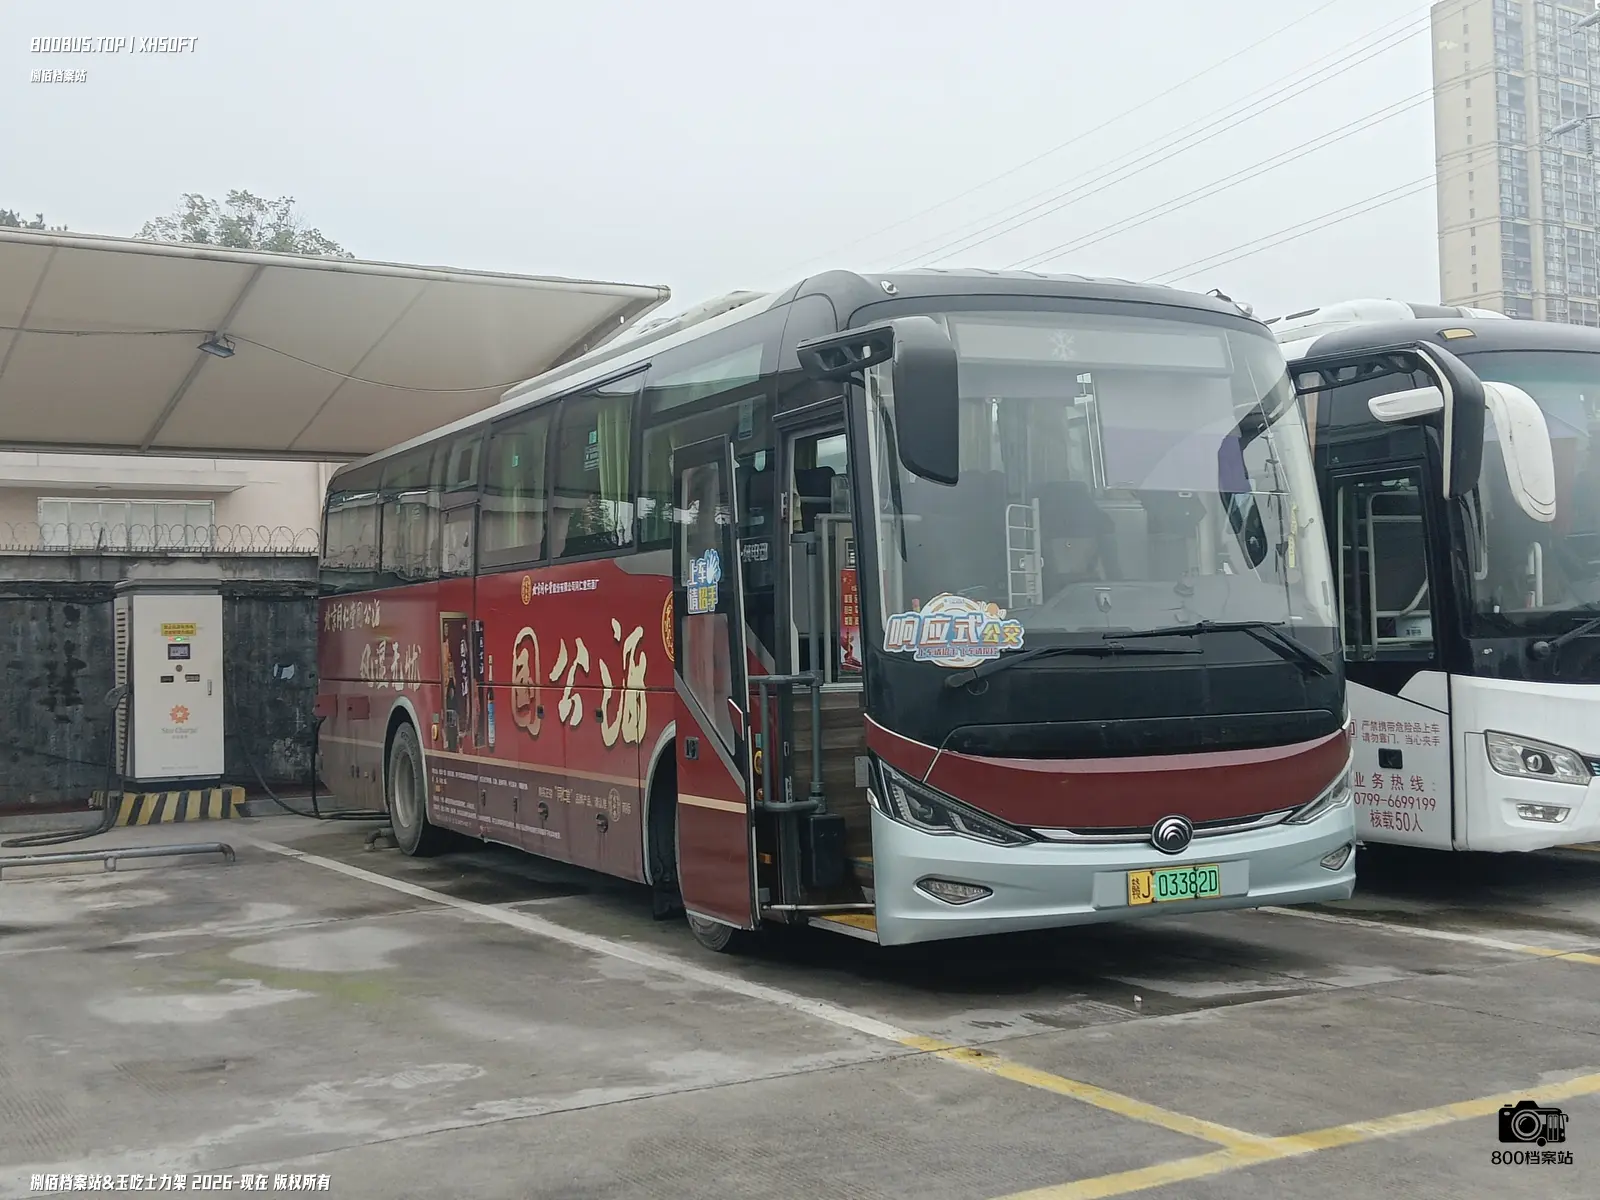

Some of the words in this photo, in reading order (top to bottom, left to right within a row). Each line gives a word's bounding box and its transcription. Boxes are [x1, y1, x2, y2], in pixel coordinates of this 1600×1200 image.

[689, 560, 707, 585] 上车
[689, 585, 717, 611] 请招手
[887, 614, 1022, 646] 响应式公交
[1361, 719, 1440, 734] 严禁携带危险品上车
[1353, 792, 1436, 812] 0799-6699199
[1369, 809, 1424, 832] 核载50人
[1158, 869, 1218, 897] 03382D
